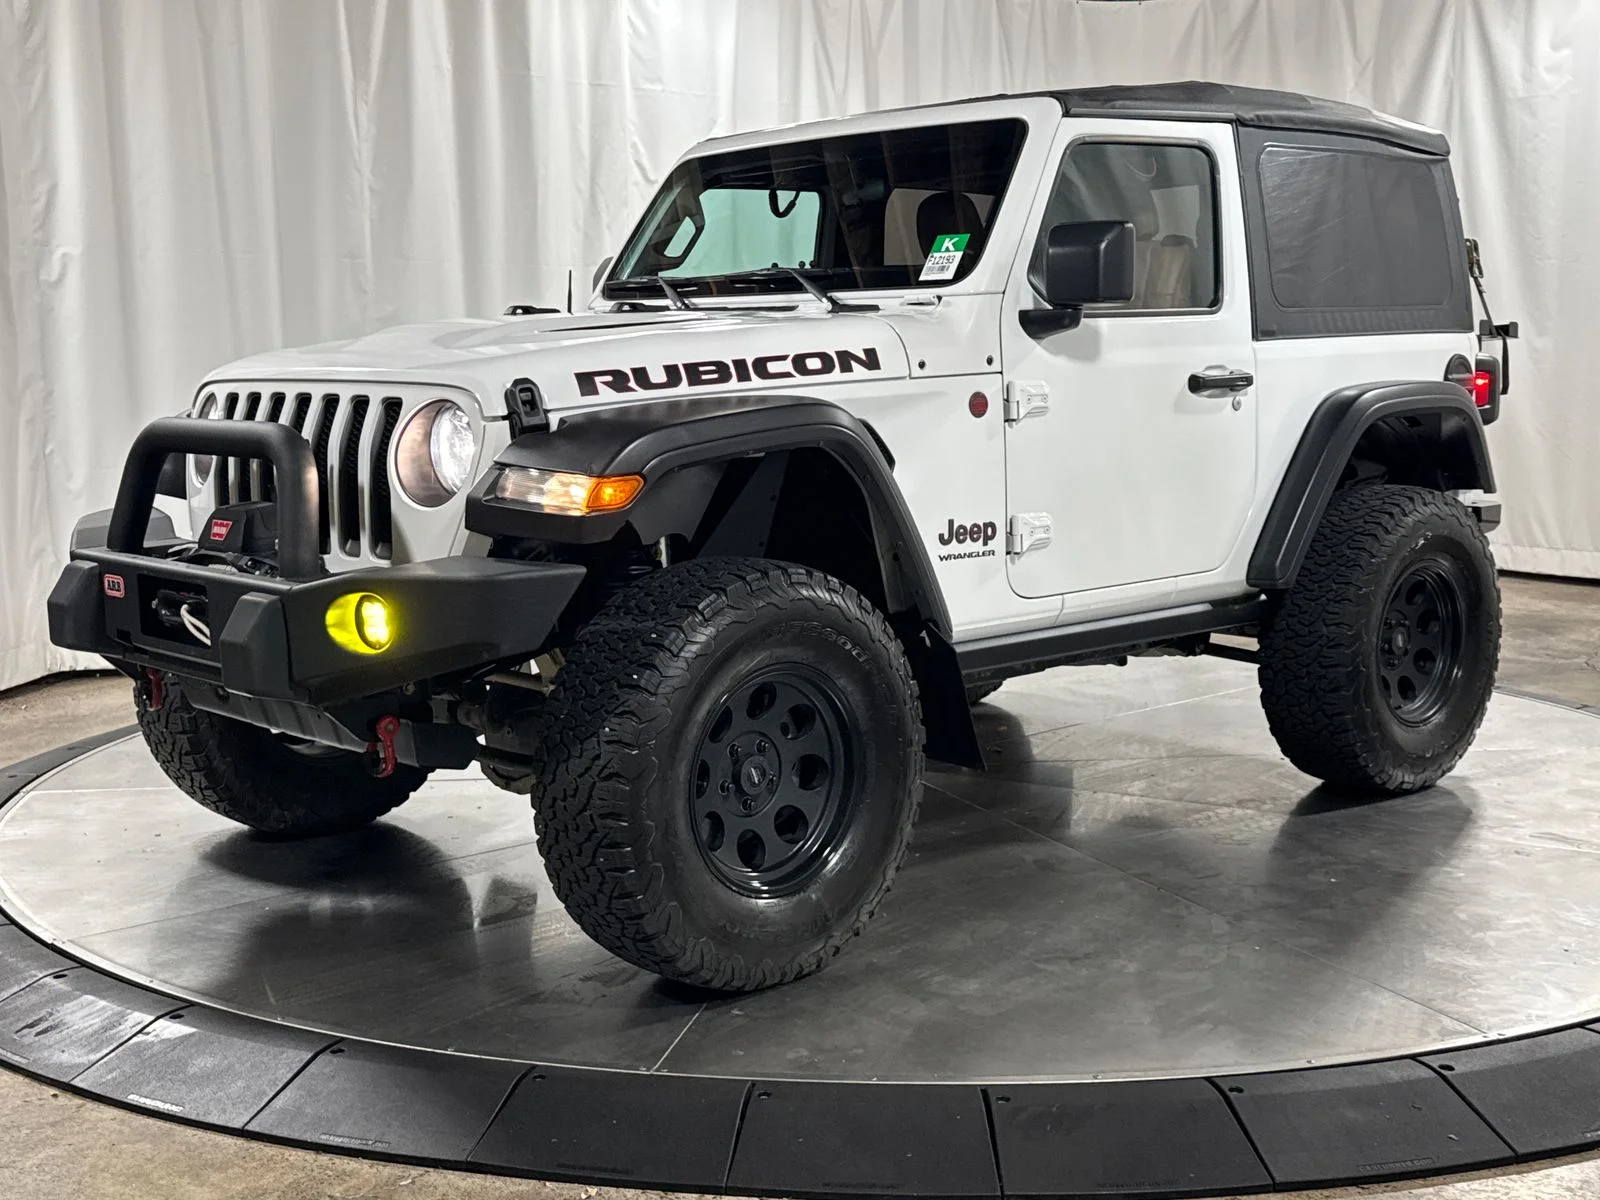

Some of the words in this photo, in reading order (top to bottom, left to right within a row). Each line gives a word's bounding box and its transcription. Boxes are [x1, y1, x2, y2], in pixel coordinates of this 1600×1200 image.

[941, 238, 960, 251] K
[573, 347, 882, 397] RUBICON
[938, 518, 997, 547] Jeep
[938, 549, 996, 562] WRANGLER
